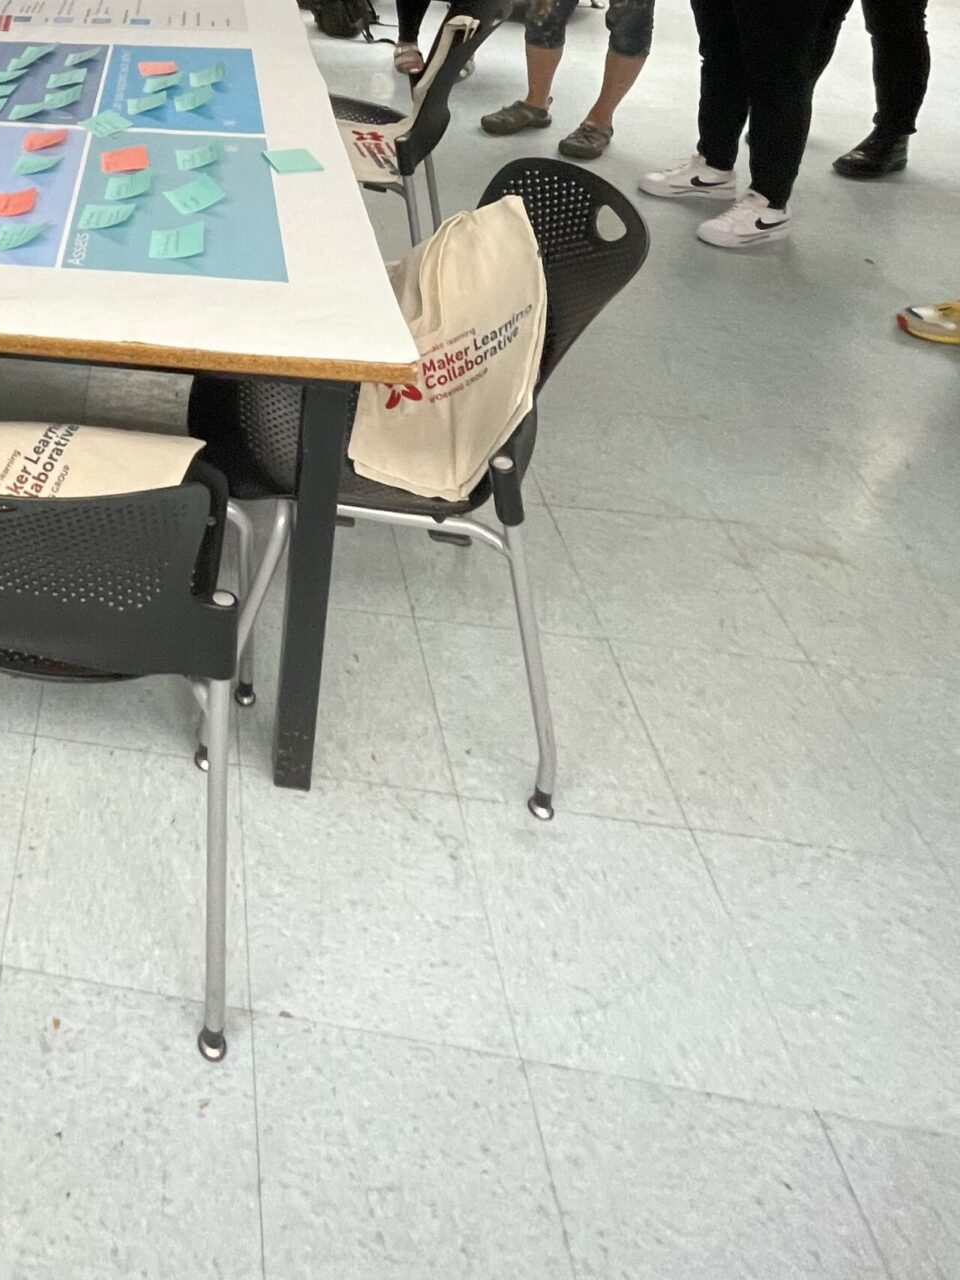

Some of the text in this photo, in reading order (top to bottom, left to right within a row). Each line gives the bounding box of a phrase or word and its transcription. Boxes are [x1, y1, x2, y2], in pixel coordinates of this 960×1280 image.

[67, 232, 90, 266] Assets
[422, 304, 534, 376] Maker Learning
[424, 326, 520, 390] Collaborative
[6, 465, 31, 495] ker
